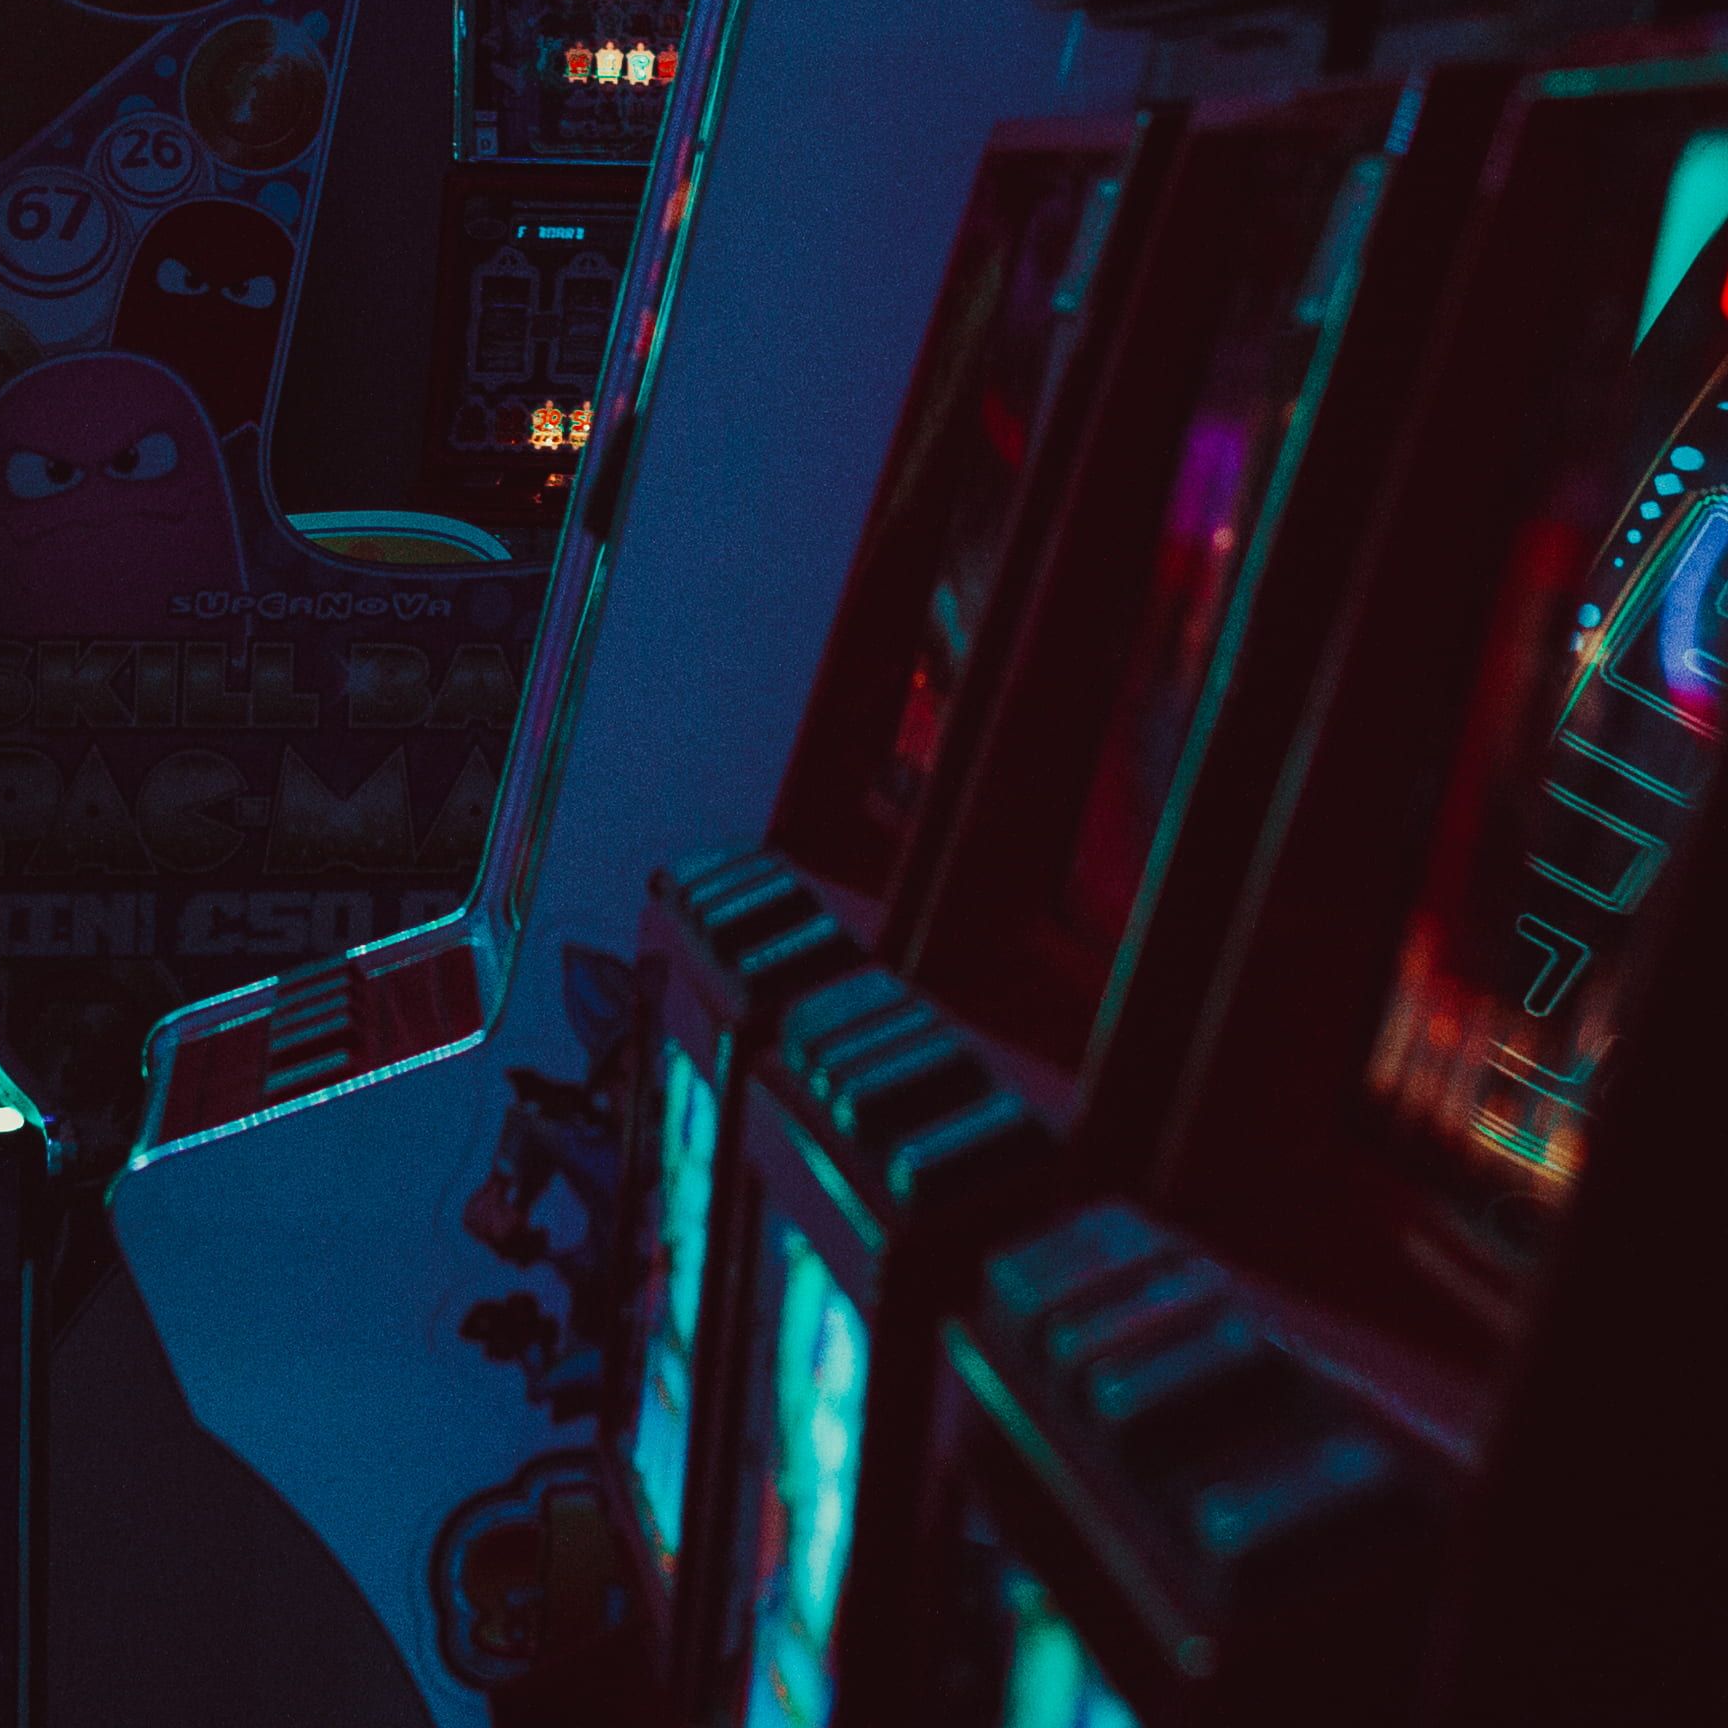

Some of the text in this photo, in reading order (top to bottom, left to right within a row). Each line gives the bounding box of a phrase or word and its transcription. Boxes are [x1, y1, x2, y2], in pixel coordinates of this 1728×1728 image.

[119, 129, 183, 171] 26
[7, 186, 92, 242] 67
[346, 640, 532, 729] BA
